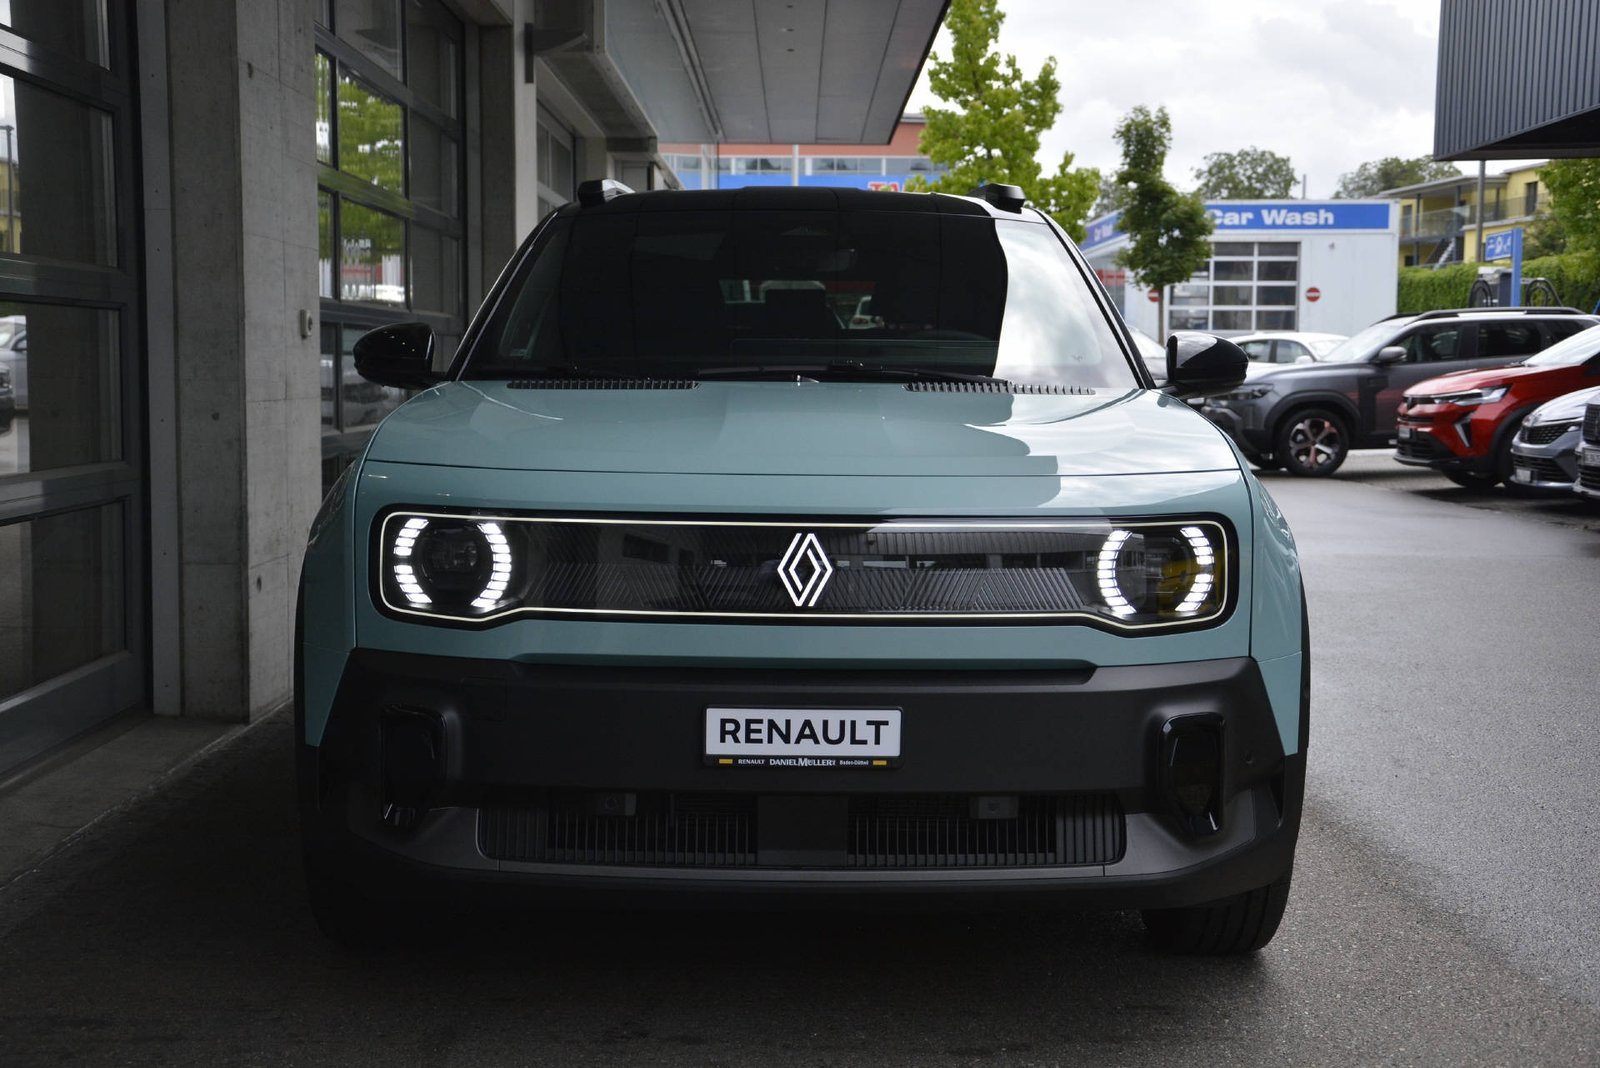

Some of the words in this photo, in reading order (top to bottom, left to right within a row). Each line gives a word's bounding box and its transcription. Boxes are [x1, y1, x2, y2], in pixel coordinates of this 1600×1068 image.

[1204, 208, 1254, 225] Car
[1261, 208, 1335, 225] Wash
[719, 717, 889, 746] RENAULT
